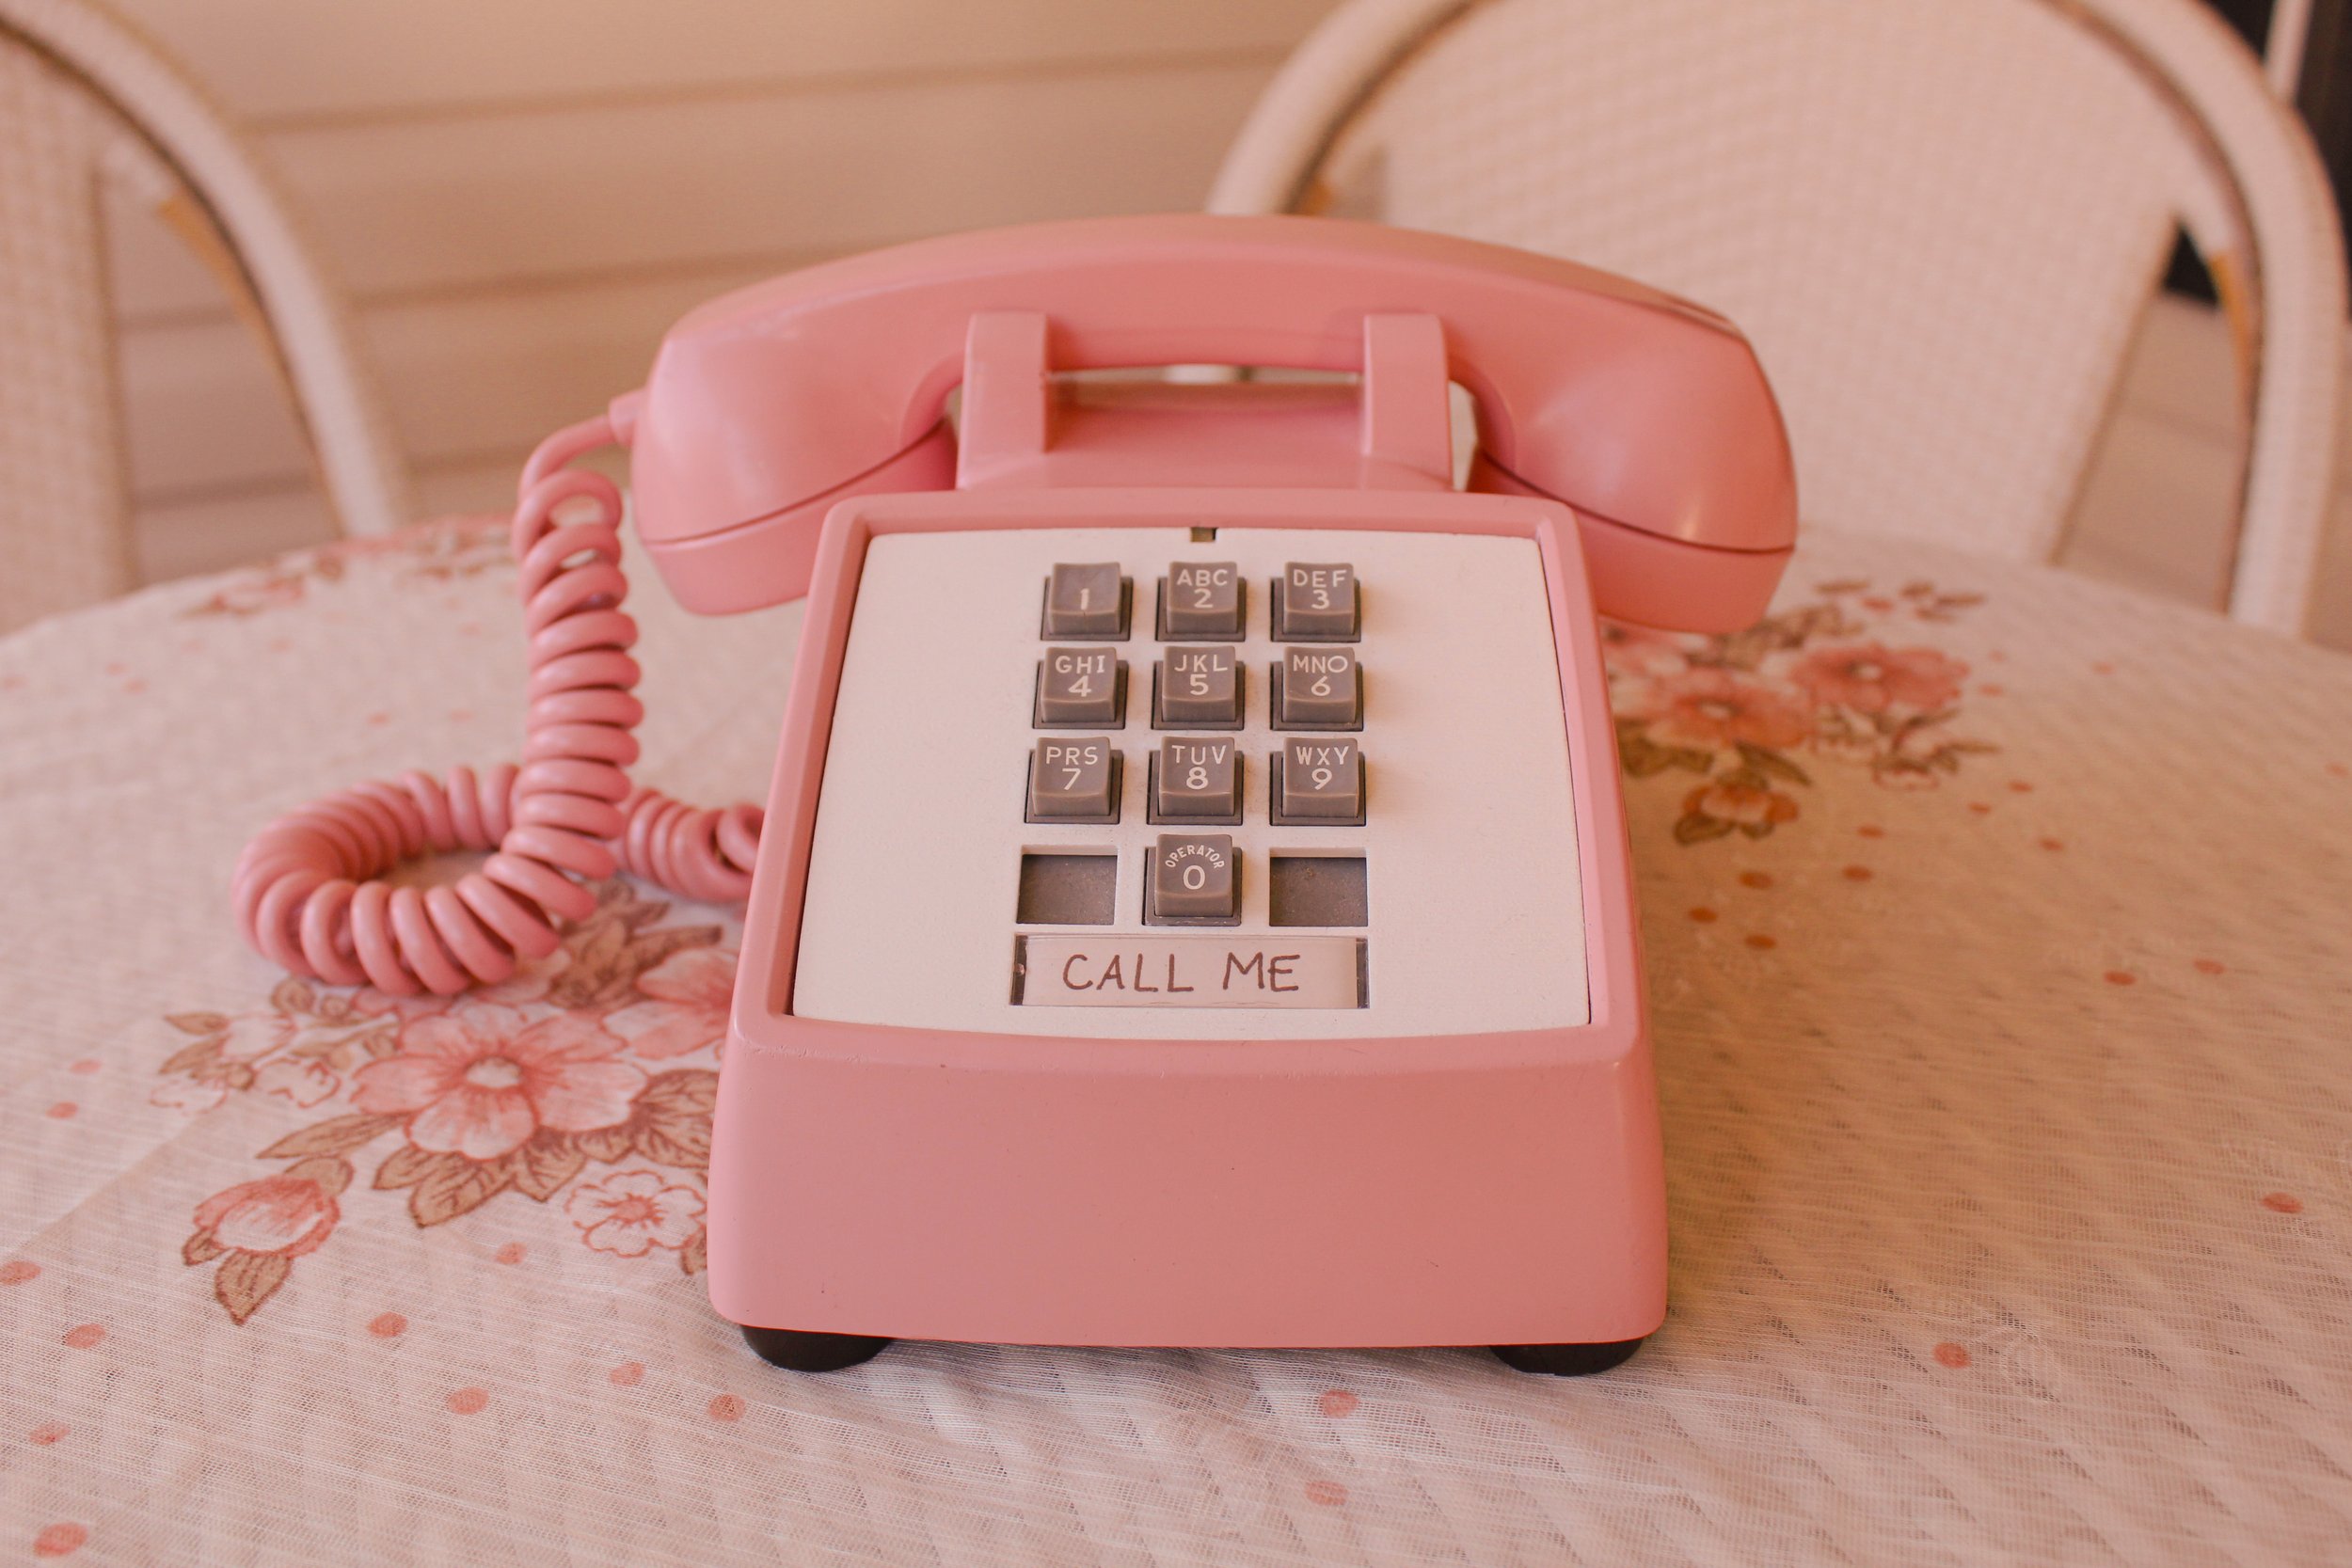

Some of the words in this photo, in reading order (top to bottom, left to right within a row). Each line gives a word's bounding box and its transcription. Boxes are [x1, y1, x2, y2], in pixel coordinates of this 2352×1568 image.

[1177, 568, 1228, 587] ABC
[1294, 569, 1347, 588] DEF
[1079, 588, 1090, 610] 1
[1194, 587, 1214, 609] 2
[1311, 589, 1330, 610] 3
[1055, 655, 1105, 674] GHI
[1174, 654, 1229, 673] JKL
[1293, 655, 1348, 673] MNO
[1068, 674, 1092, 698] 4
[1189, 673, 1209, 696] 5
[1311, 675, 1331, 697] 6
[1046, 746, 1099, 766] PRS
[1171, 744, 1227, 766] TUV
[1295, 745, 1349, 766] WXY
[1062, 768, 1082, 791] 7
[1185, 766, 1209, 790] 8
[1311, 768, 1333, 791] 9
[1165, 844, 1225, 869] OPERATOR
[1183, 864, 1206, 890] 0
[1063, 954, 1194, 992] CALL
[1223, 952, 1300, 992] ME
